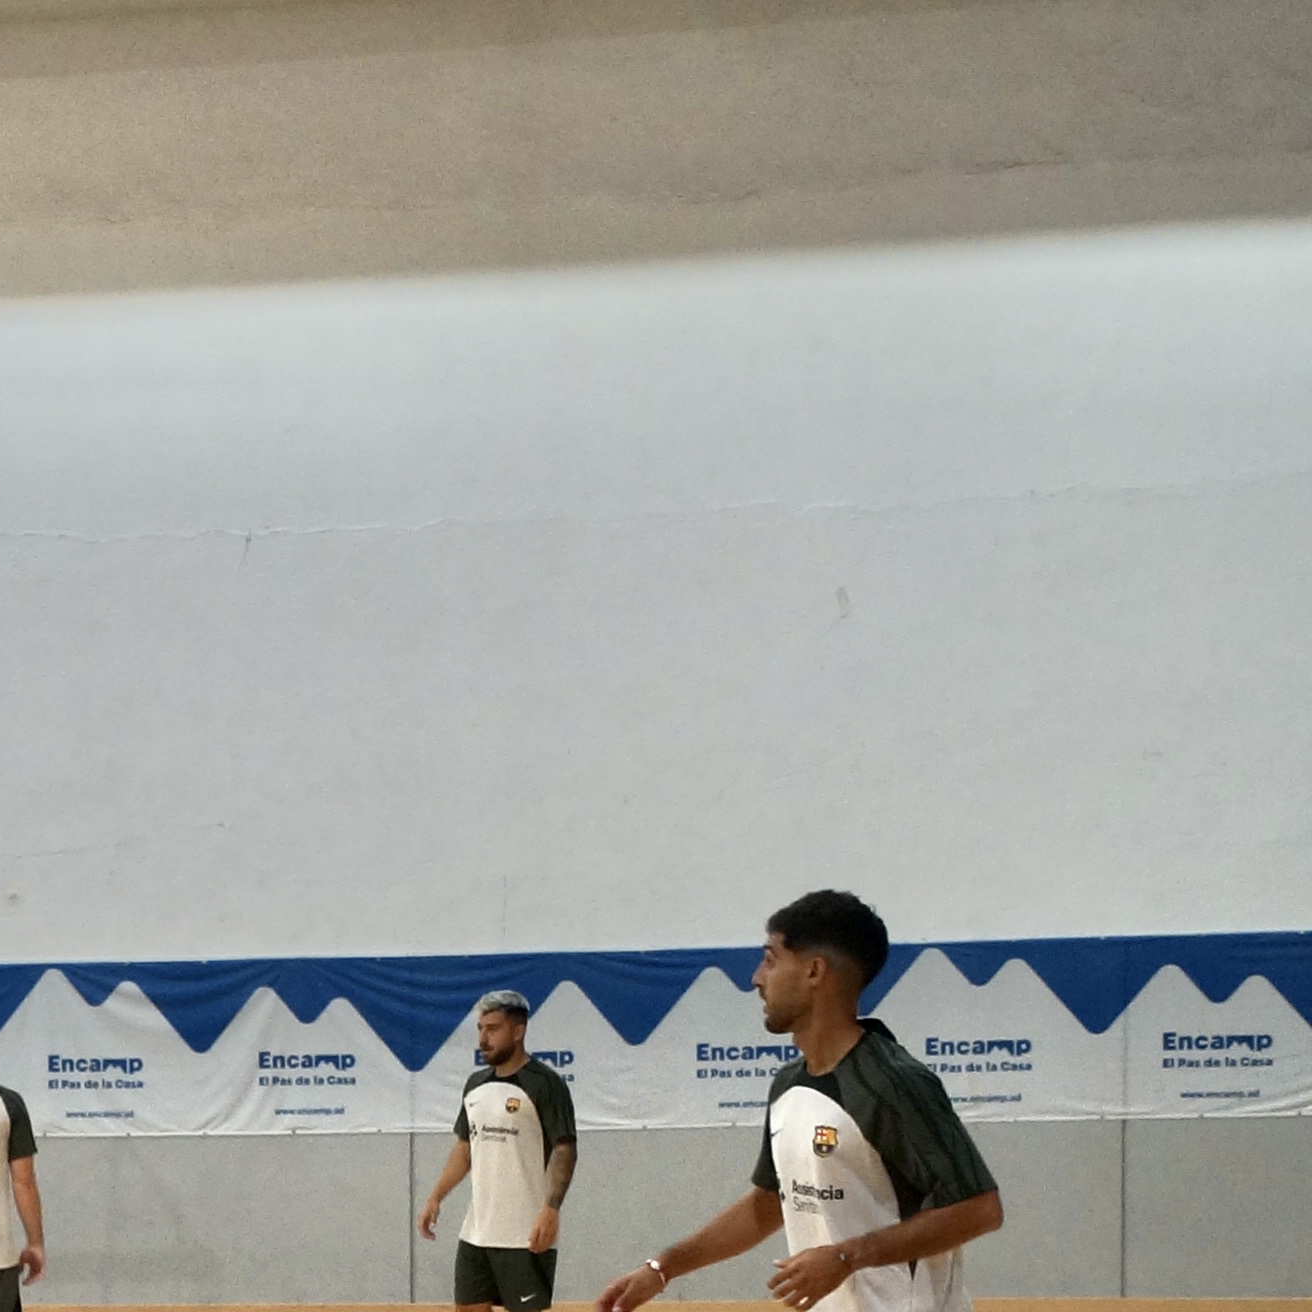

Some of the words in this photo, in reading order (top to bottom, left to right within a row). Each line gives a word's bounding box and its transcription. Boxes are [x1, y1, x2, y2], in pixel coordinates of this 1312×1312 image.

[925, 1037, 1032, 1056] Encamp
[1163, 1032, 1273, 1051] Encamp
[259, 1051, 356, 1071] Encamp
[696, 1044, 799, 1061] Encamp
[48, 1055, 143, 1074] Encamp
